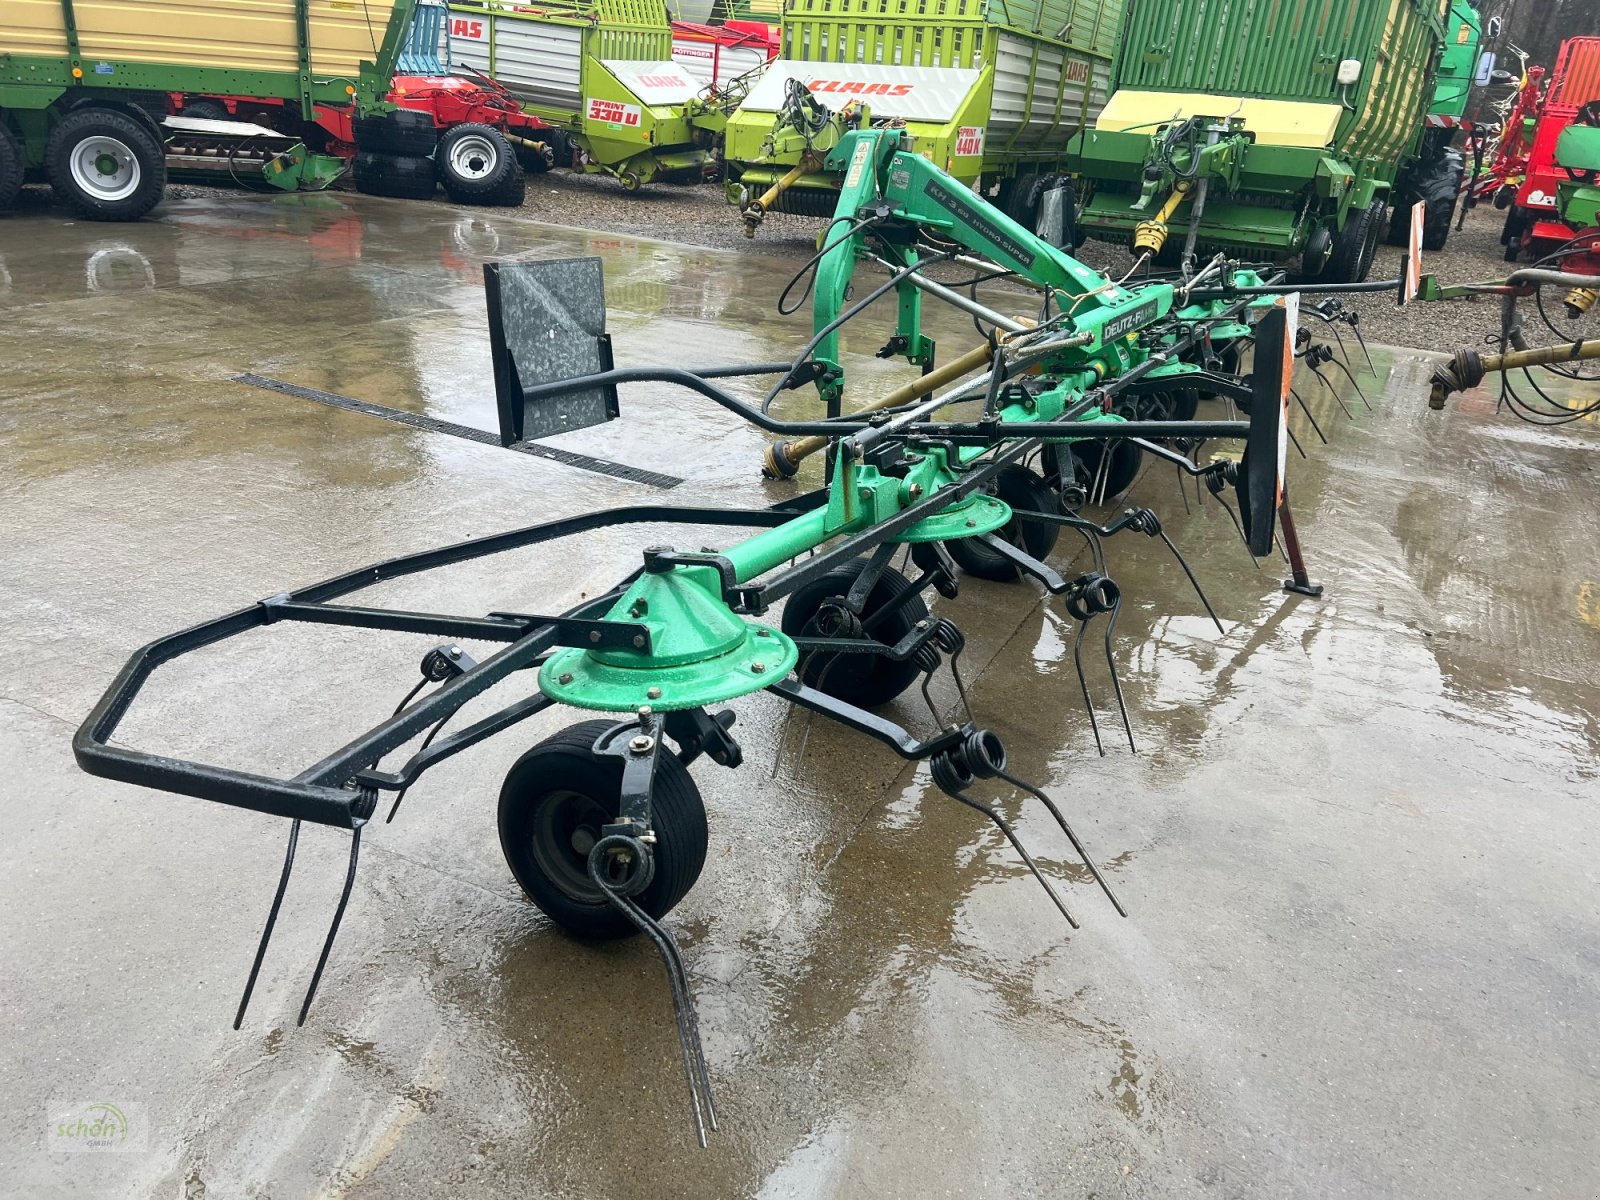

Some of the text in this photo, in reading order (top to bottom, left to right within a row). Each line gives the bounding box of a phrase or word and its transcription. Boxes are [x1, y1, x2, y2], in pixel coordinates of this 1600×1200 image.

[637, 75, 687, 87] CLAAS
[807, 79, 915, 96] CLAAS
[592, 99, 625, 111] SPRINT
[589, 106, 639, 126] 330 U
[956, 137, 981, 155] 440 K
[930, 185, 947, 201] KH
